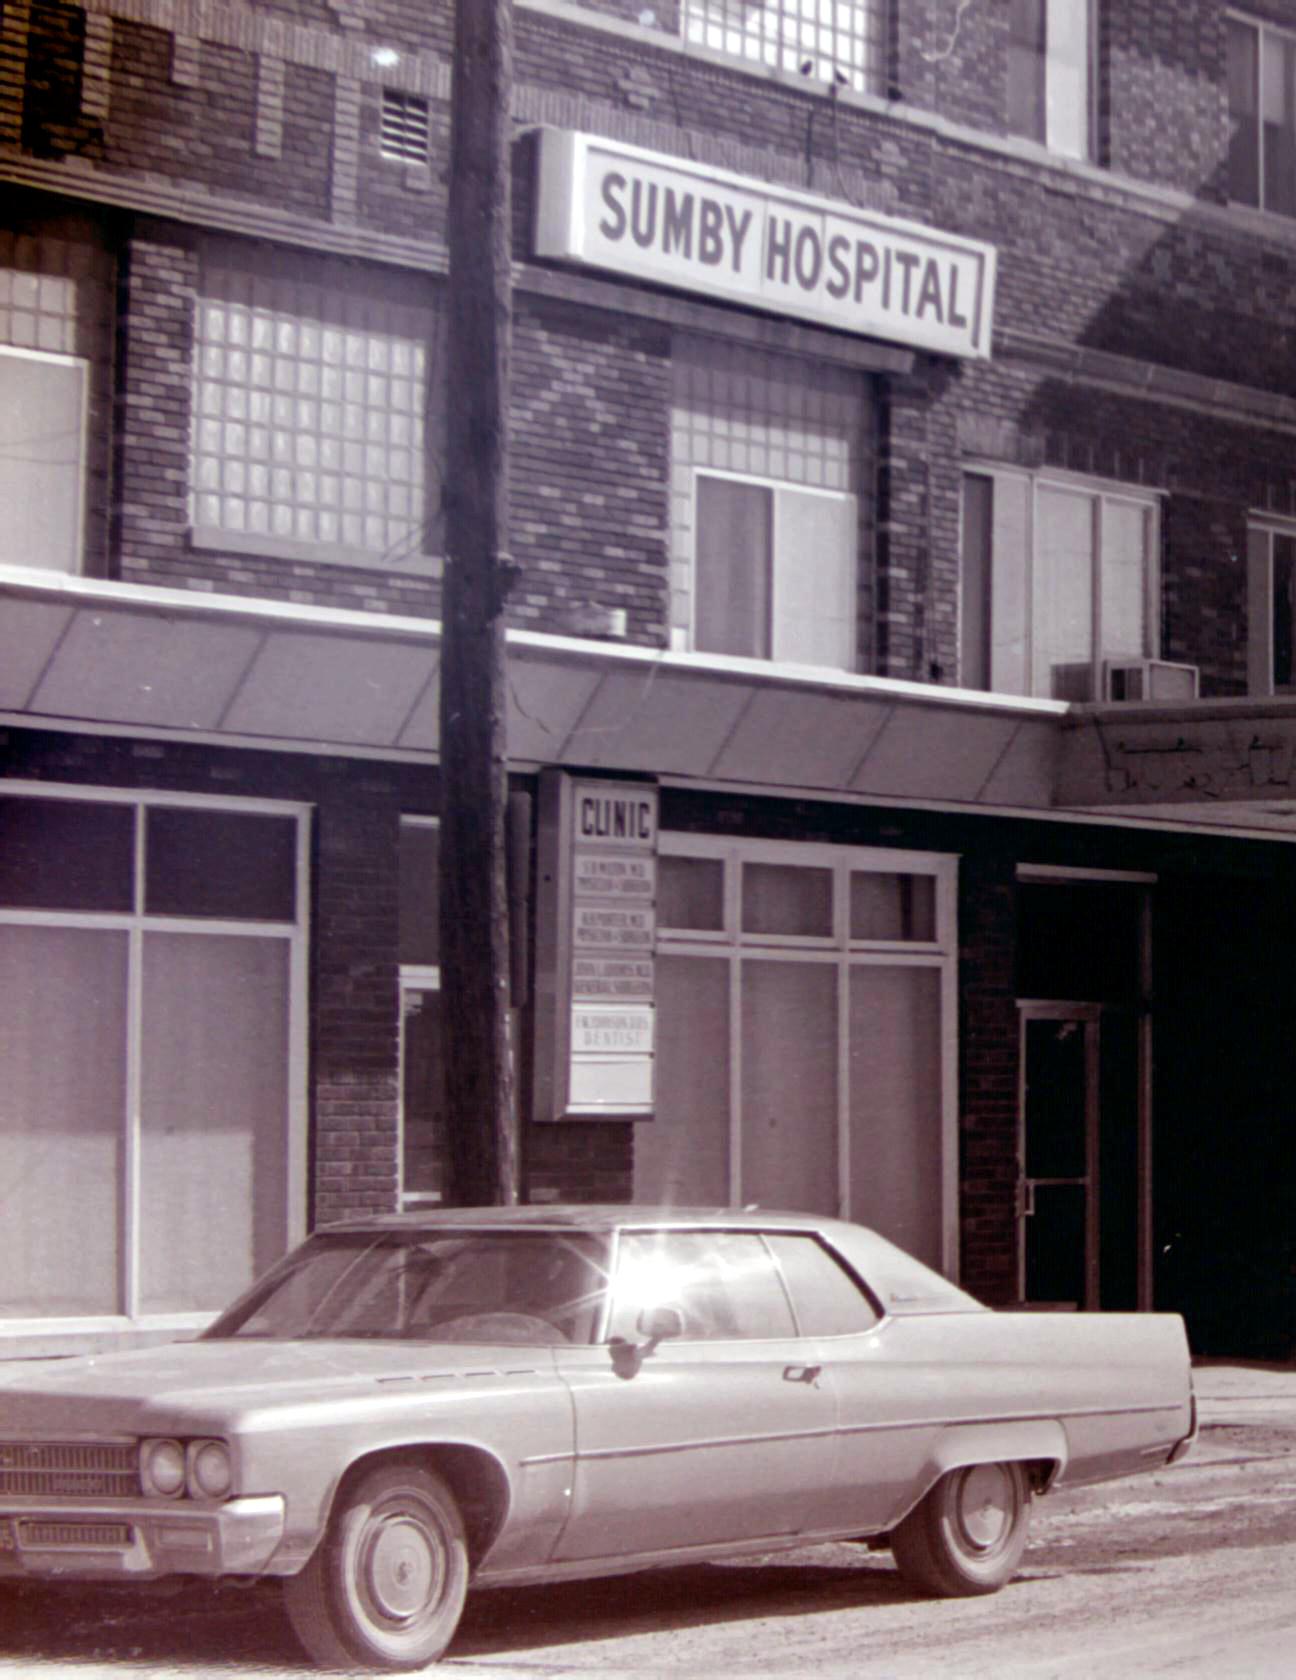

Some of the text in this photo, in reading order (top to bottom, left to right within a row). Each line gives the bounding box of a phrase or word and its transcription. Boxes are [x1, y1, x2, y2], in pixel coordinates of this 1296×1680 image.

[599, 172, 968, 329] SUMBY HOSPITAL
[581, 797, 650, 839] CLINIC
